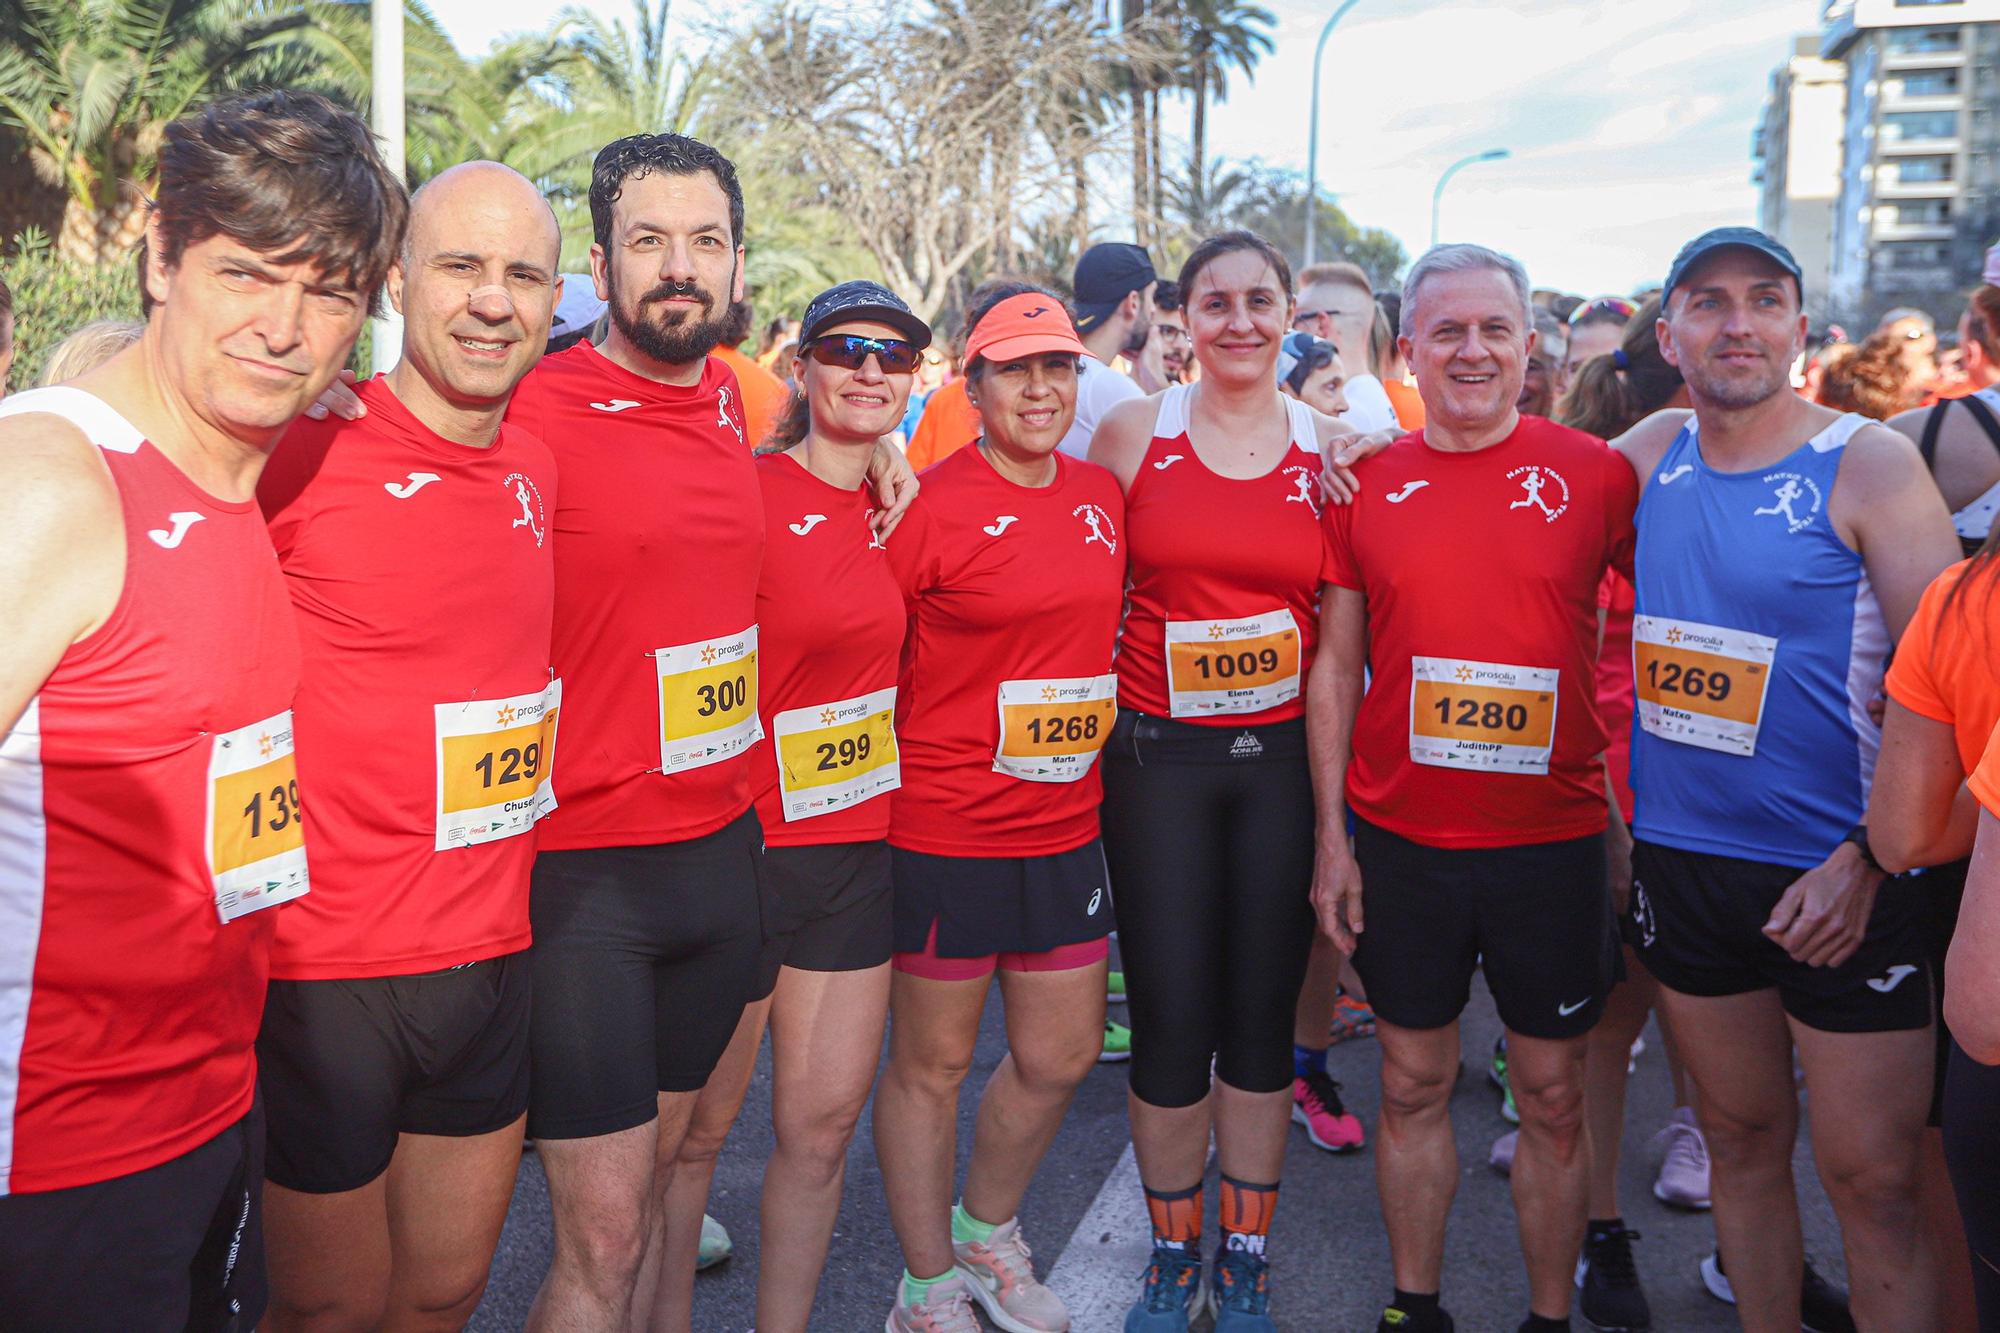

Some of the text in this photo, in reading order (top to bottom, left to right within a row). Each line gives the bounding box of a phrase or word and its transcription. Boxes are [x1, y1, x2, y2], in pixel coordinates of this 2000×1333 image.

[1763, 473, 1802, 484] NATXO
[1506, 466, 1569, 523] NATXO TRAINING TEAM
[1226, 623, 1261, 636] prosolia
[1682, 633, 1724, 646] prosolia
[1194, 648, 1278, 679] 1009
[1475, 670, 1516, 681] prosolia
[1647, 659, 1731, 701] 1269
[697, 675, 746, 717] 300
[1059, 686, 1090, 698] prosolia
[1228, 689, 1255, 698] Elena
[1434, 696, 1528, 732] 1280
[1662, 707, 1692, 721] Natxo
[1027, 714, 1099, 744] 1268
[816, 733, 871, 772] 299
[1455, 740, 1503, 753] JudithPP
[1052, 755, 1076, 764] Marta
